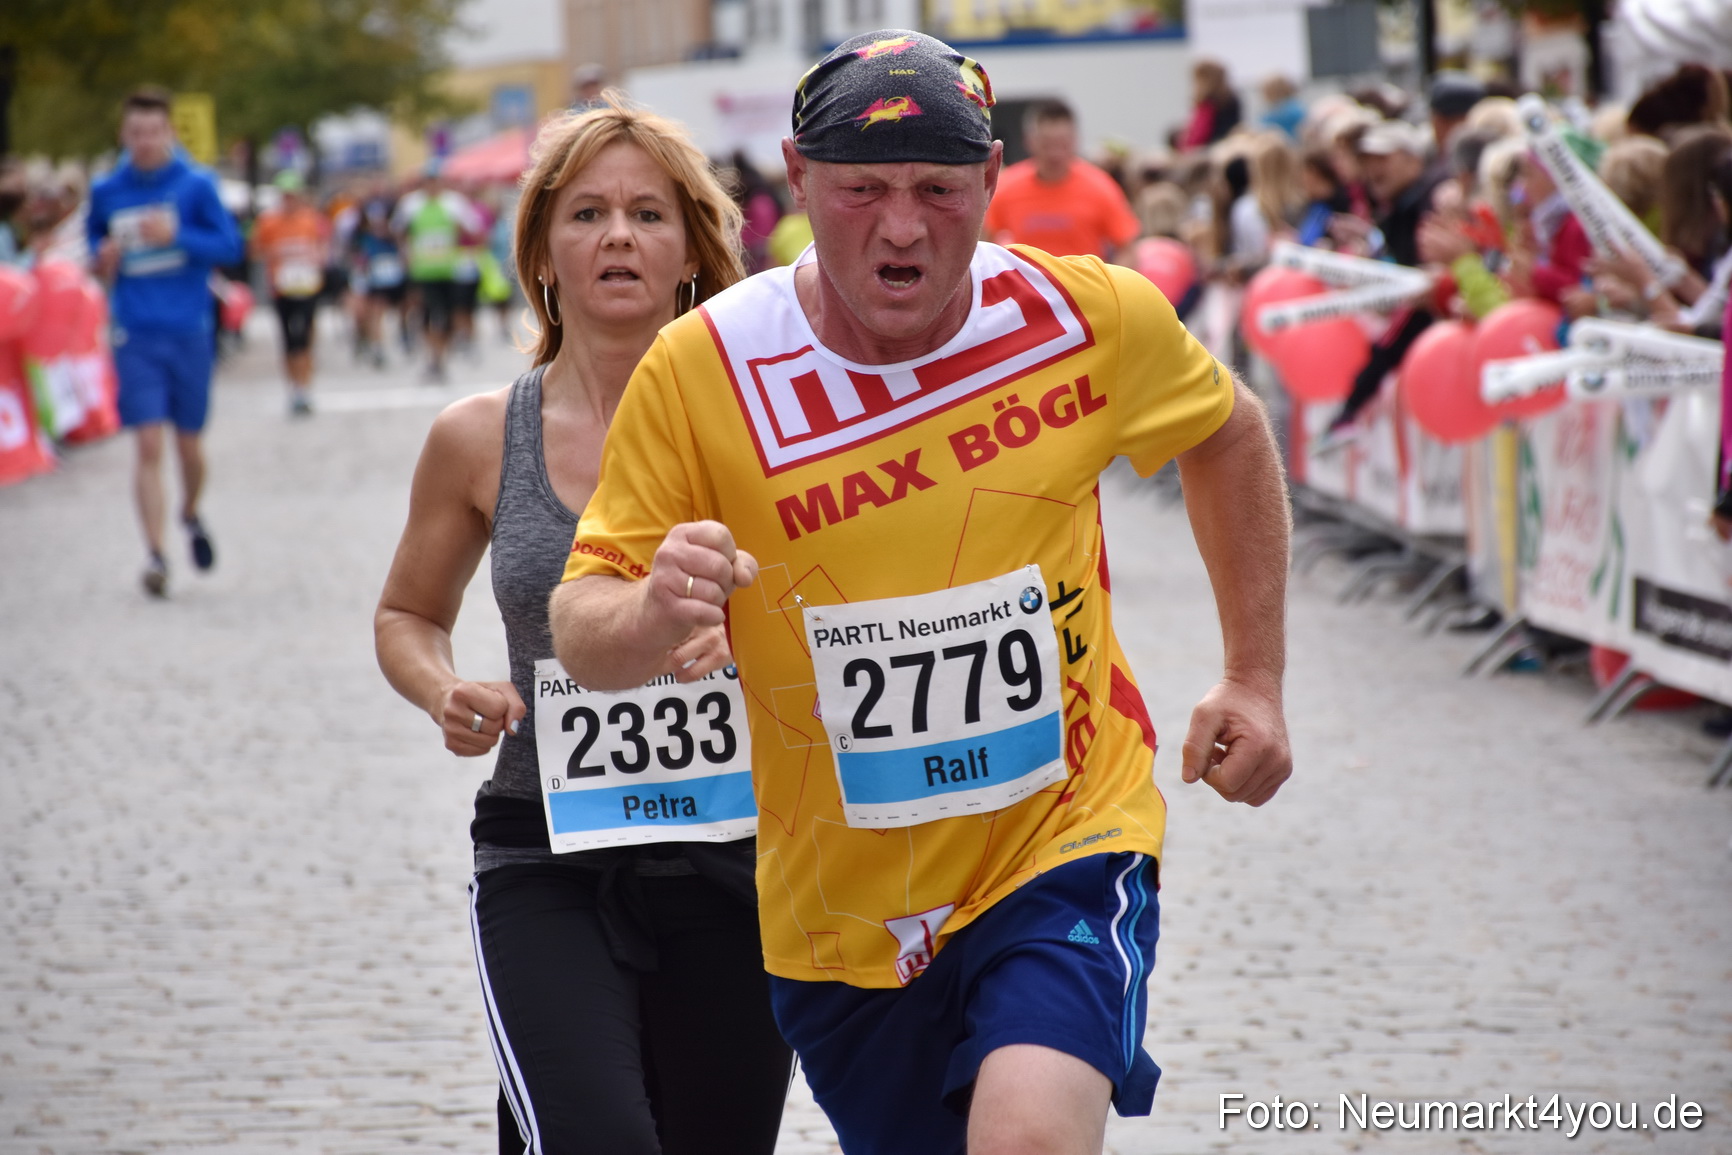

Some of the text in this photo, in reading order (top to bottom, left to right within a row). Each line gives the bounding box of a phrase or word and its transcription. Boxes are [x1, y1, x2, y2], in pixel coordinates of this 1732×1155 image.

[775, 375, 1107, 541] MAX BÖGL
[814, 600, 1012, 648] PARTL Neumarkt
[843, 629, 1042, 739] 2779
[561, 691, 737, 780] 2333
[839, 736, 848, 749] C
[552, 778, 560, 790] D
[924, 747, 989, 787] Ralf
[622, 793, 698, 820] Petra
[1068, 934, 1099, 945] adidas
